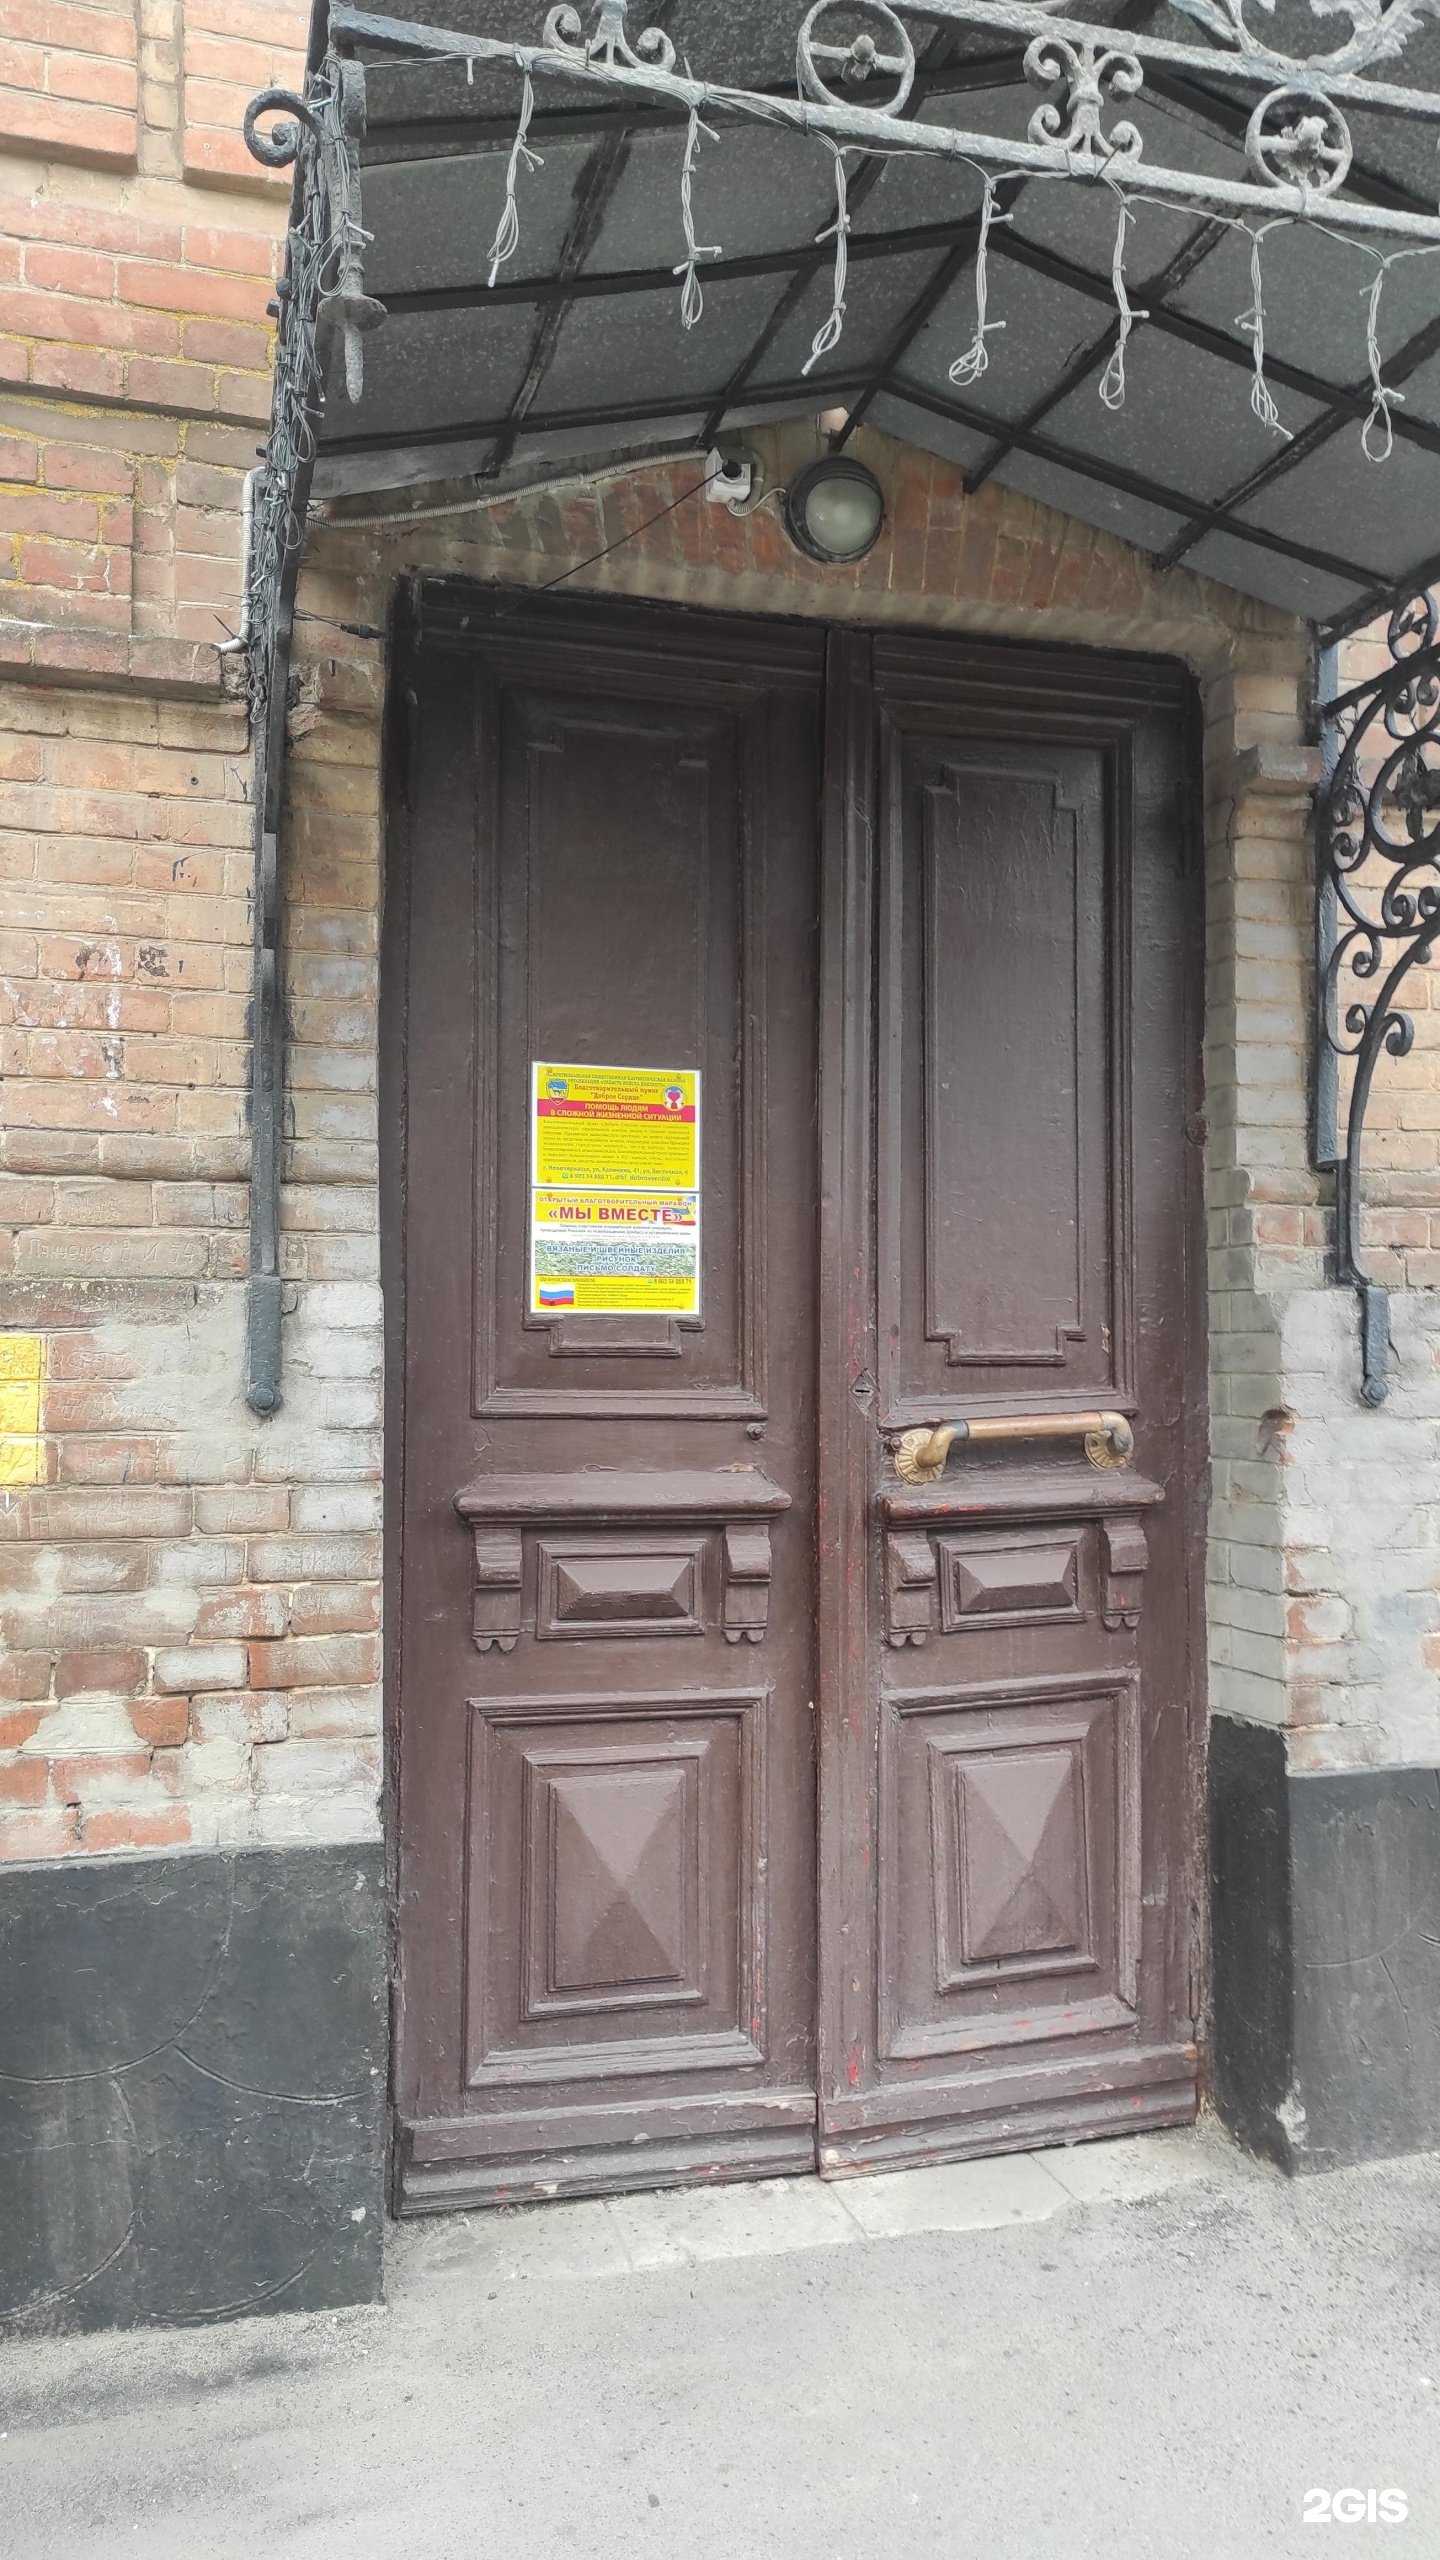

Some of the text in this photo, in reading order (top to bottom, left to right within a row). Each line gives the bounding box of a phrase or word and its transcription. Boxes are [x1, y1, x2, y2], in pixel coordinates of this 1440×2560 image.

[584, 1103, 649, 1113] ПОМОЩЬ ЛЮДЯМ
[556, 1109, 596, 1117] СЛОЖНОЙ
[596, 1111, 643, 1120] ЖИЗНЕННОЙ
[643, 1113, 682, 1121] СИТУАЦИИ
[548, 1206, 682, 1222] «МЫ ВМЕСТЕ»
[599, 1246, 642, 1254] ШВЕЙНЫЕ
[646, 1247, 685, 1255] ИЗДЕЛИЯ
[596, 1255, 636, 1263] РИСУНОК
[616, 1265, 655, 1273] СОЛДАТУ
